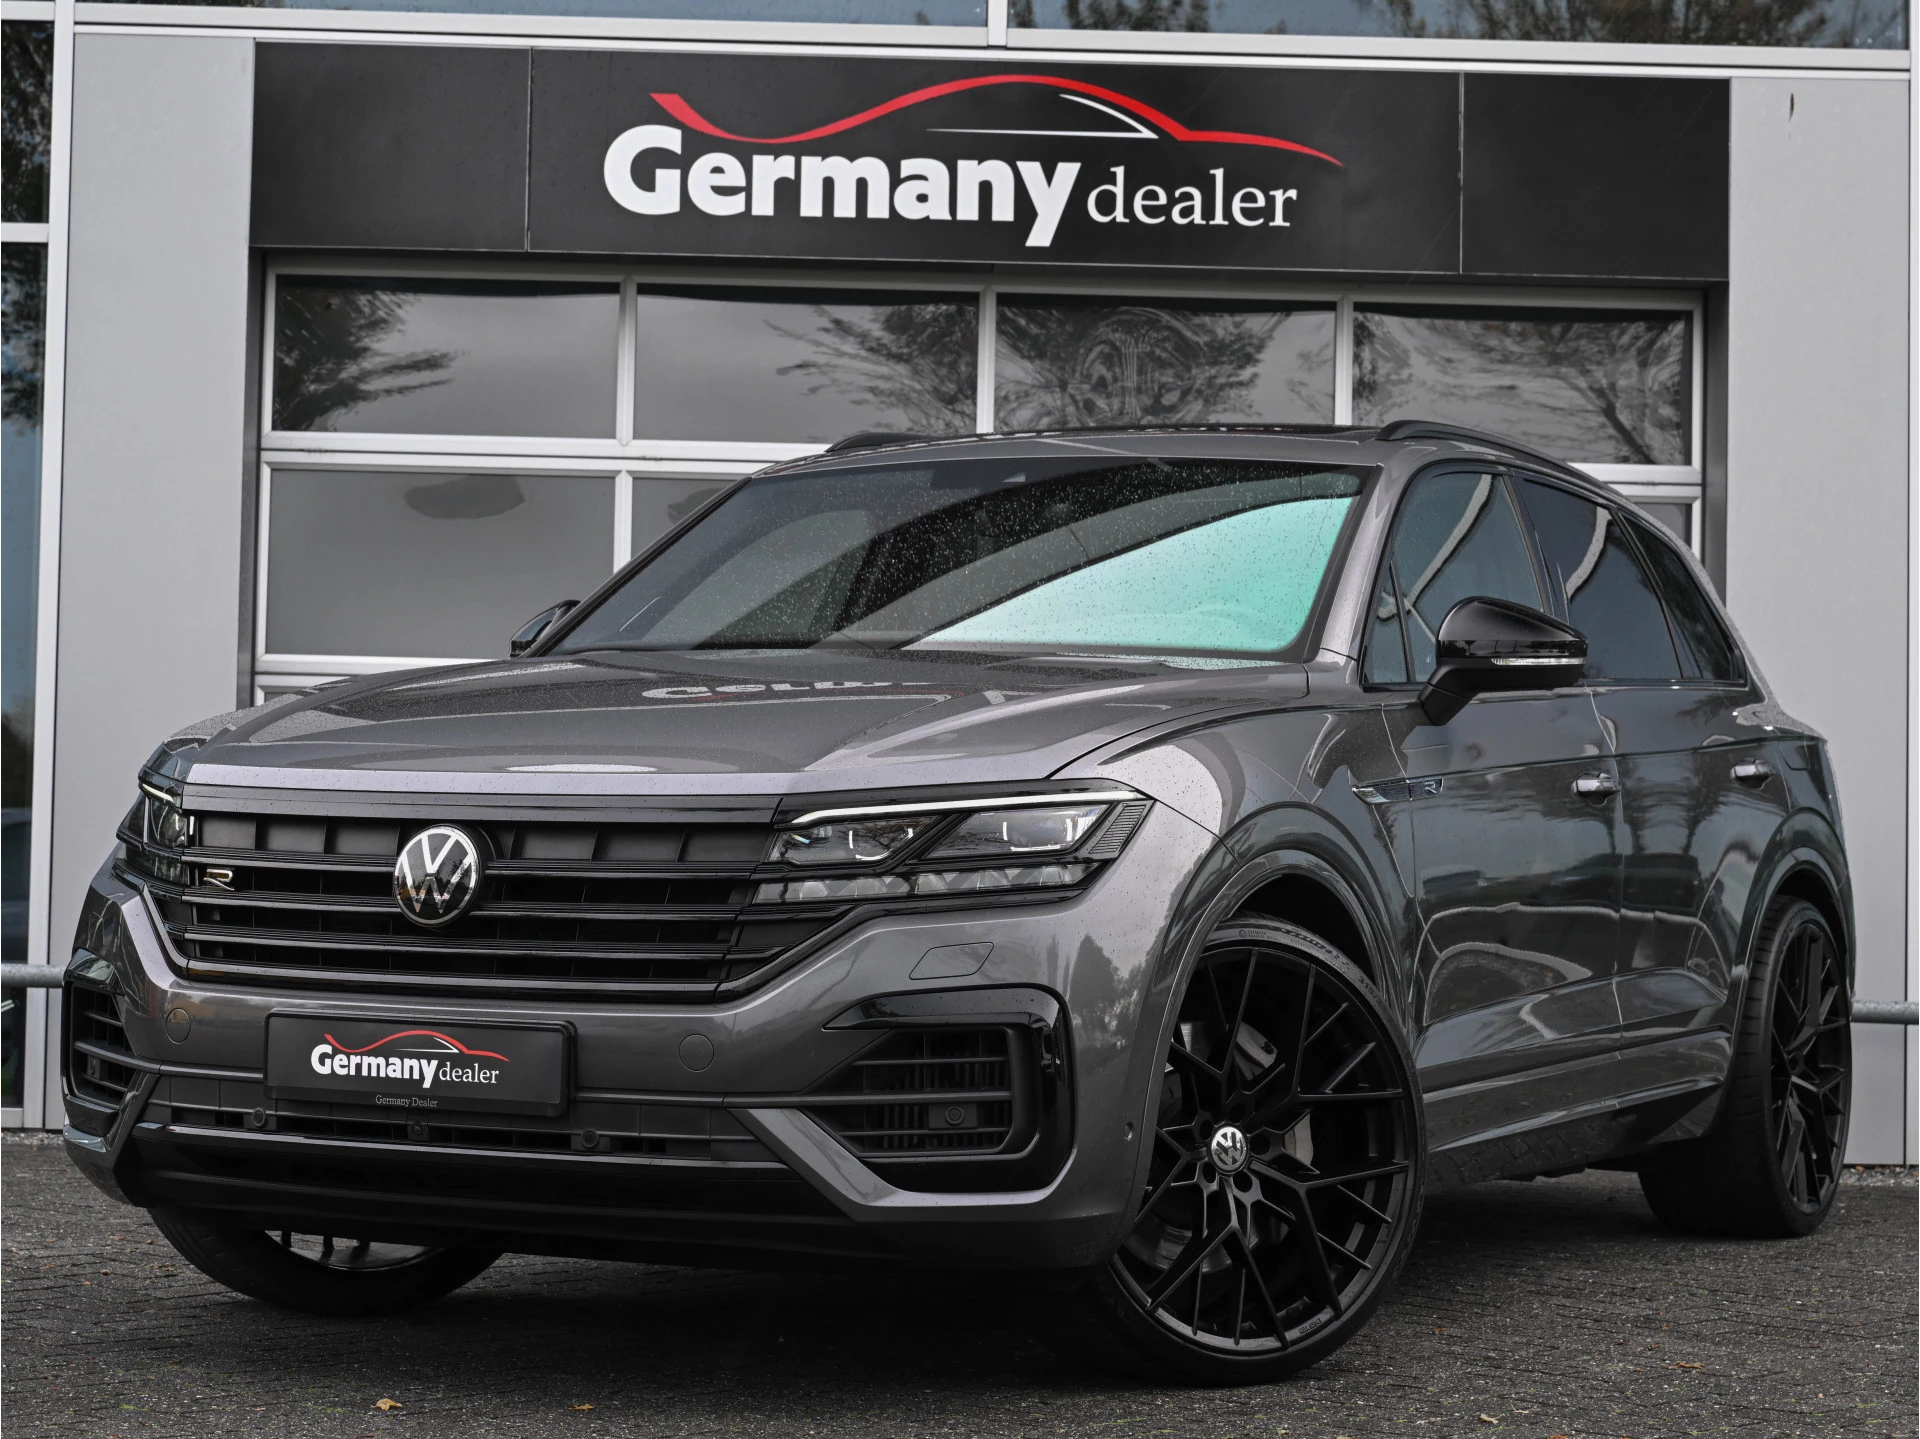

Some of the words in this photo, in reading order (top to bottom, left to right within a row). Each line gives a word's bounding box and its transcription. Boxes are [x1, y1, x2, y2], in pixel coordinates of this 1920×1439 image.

[603, 124, 1082, 247] Germany
[1086, 167, 1298, 227] dealer
[203, 868, 235, 890] R
[310, 1043, 439, 1089] Germany
[438, 1062, 500, 1084] dealer
[375, 1094, 411, 1108] Germany
[411, 1097, 439, 1108] Dealer
